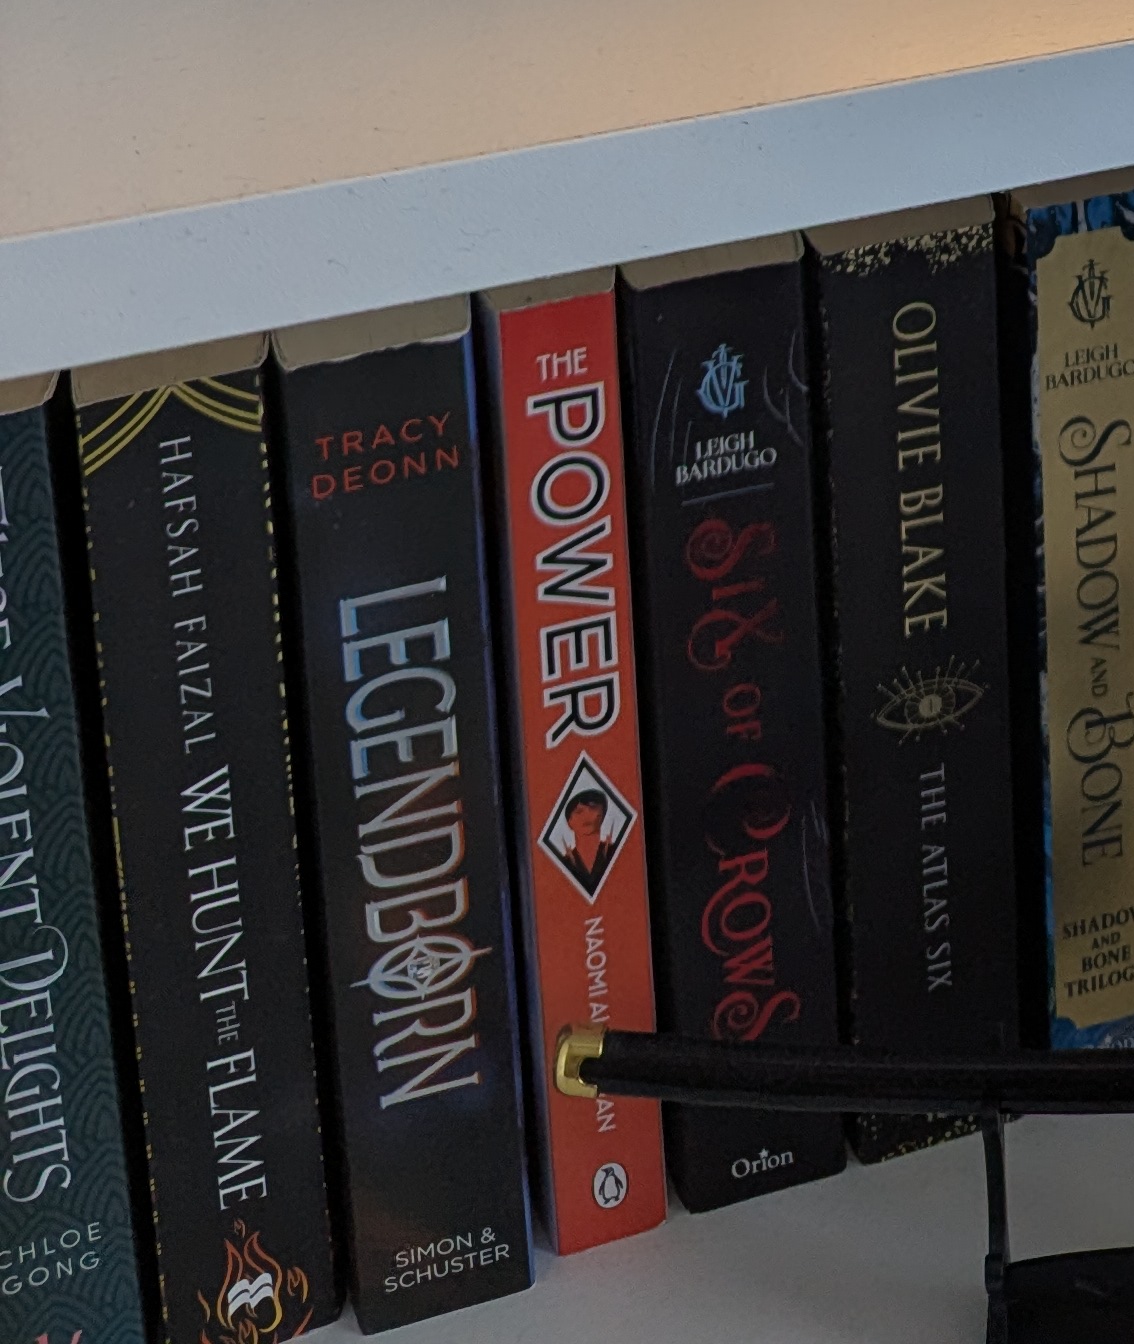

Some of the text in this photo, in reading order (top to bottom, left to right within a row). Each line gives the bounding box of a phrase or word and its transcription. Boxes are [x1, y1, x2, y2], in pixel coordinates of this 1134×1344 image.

[535, 346, 589, 382] THE
[1064, 343, 1119, 369] LEIGH
[314, 412, 452, 461] TRACY
[694, 430, 756, 460] LEIGH
[310, 444, 460, 501] DEONN
[674, 446, 778, 486] BARDUGO
[891, 300, 948, 640] OLIVIE BLAKE
[1058, 414, 1132, 651] SHADOW
[526, 380, 623, 749] POWER
[159, 435, 217, 756] HAFSAH FAIZAL
[686, 517, 784, 670] SIX
[1091, 656, 1109, 698] AND
[722, 681, 762, 740] OF
[338, 573, 485, 1110] LEGENDBORN
[701, 762, 801, 1041] CROWS
[919, 762, 953, 993] THE ATLAS SIX
[584, 915, 610, 998] NAOMI
[1081, 945, 1132, 974] BONE
[1091, 930, 1122, 951] AND
[179, 763, 268, 1212] WE HUNT THE FLAME
[731, 1148, 795, 1180] Orion
[1, 1250, 101, 1296] GONG
[383, 1242, 511, 1294] SCHUSTER
[394, 1226, 497, 1269] SIMON &
